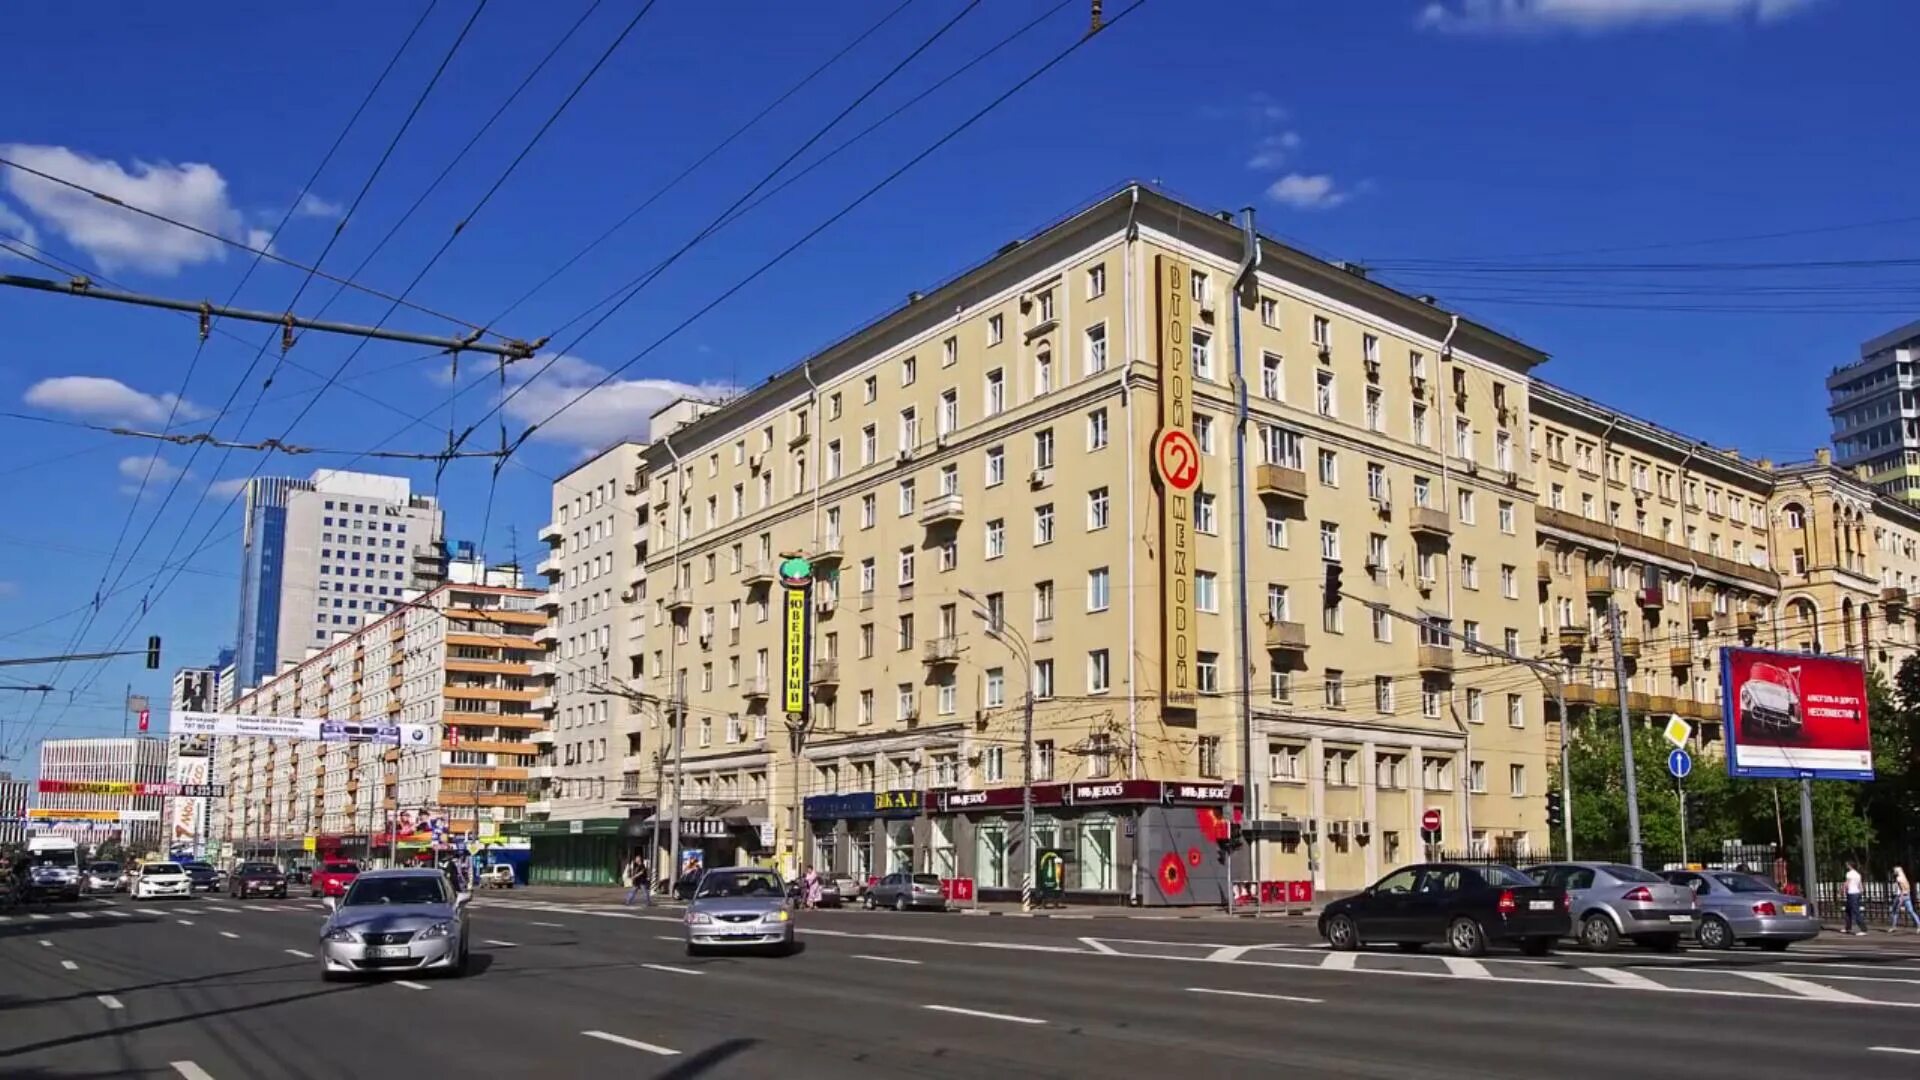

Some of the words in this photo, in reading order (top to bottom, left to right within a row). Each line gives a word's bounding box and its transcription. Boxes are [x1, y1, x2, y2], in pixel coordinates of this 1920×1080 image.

[1170, 265, 1184, 428] ВТОРОЙ
[789, 599, 803, 703] ЮВЕЛИРНЫЙ
[1173, 495, 1187, 688] МЕХОВОЙ
